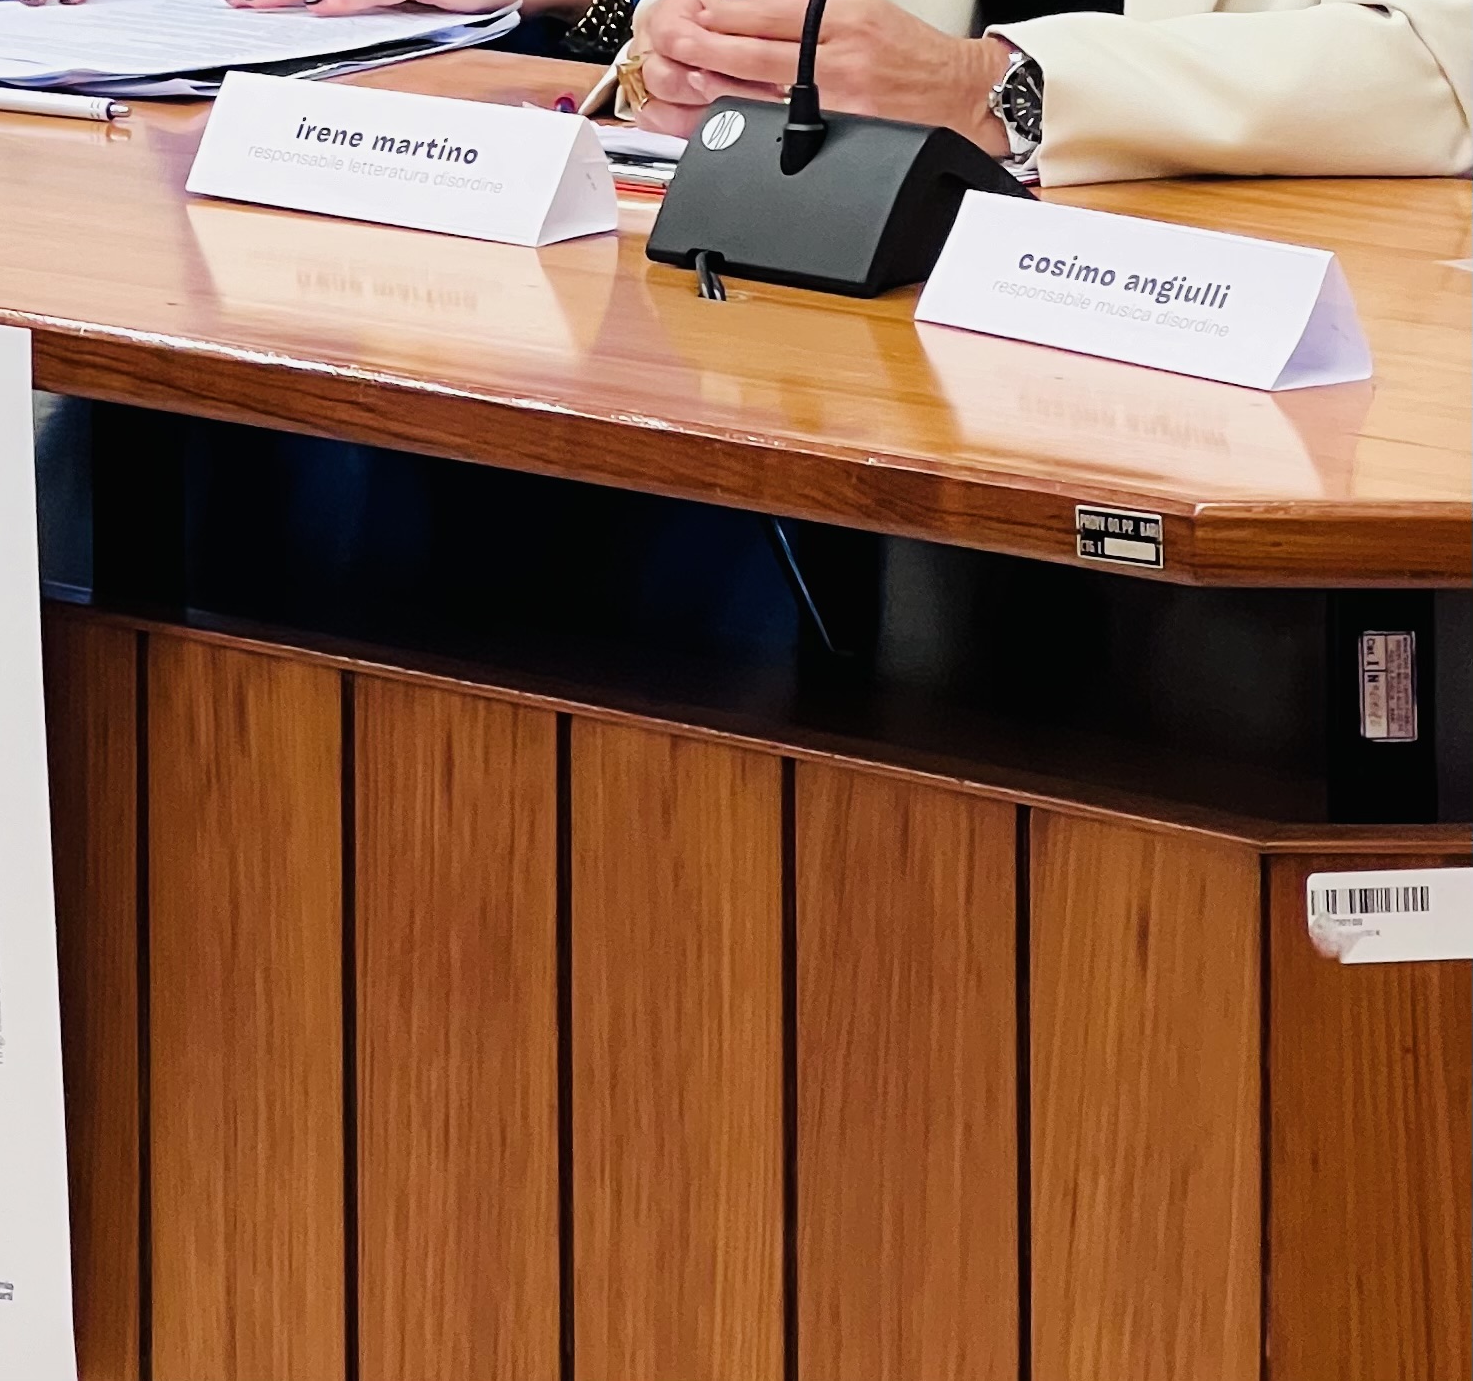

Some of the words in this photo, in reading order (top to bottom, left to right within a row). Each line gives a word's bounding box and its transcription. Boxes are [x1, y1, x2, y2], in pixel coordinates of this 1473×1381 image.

[295, 116, 365, 148] irene
[372, 134, 479, 166] martino
[248, 143, 345, 171] responsabile
[348, 158, 430, 185] letteratura
[434, 170, 504, 196] disordine
[992, 278, 1092, 311] responsabile
[1095, 298, 1152, 324] musica
[1156, 310, 1230, 339] disordine
[1018, 251, 1117, 288] cosimo
[1124, 273, 1232, 311] angiulli
